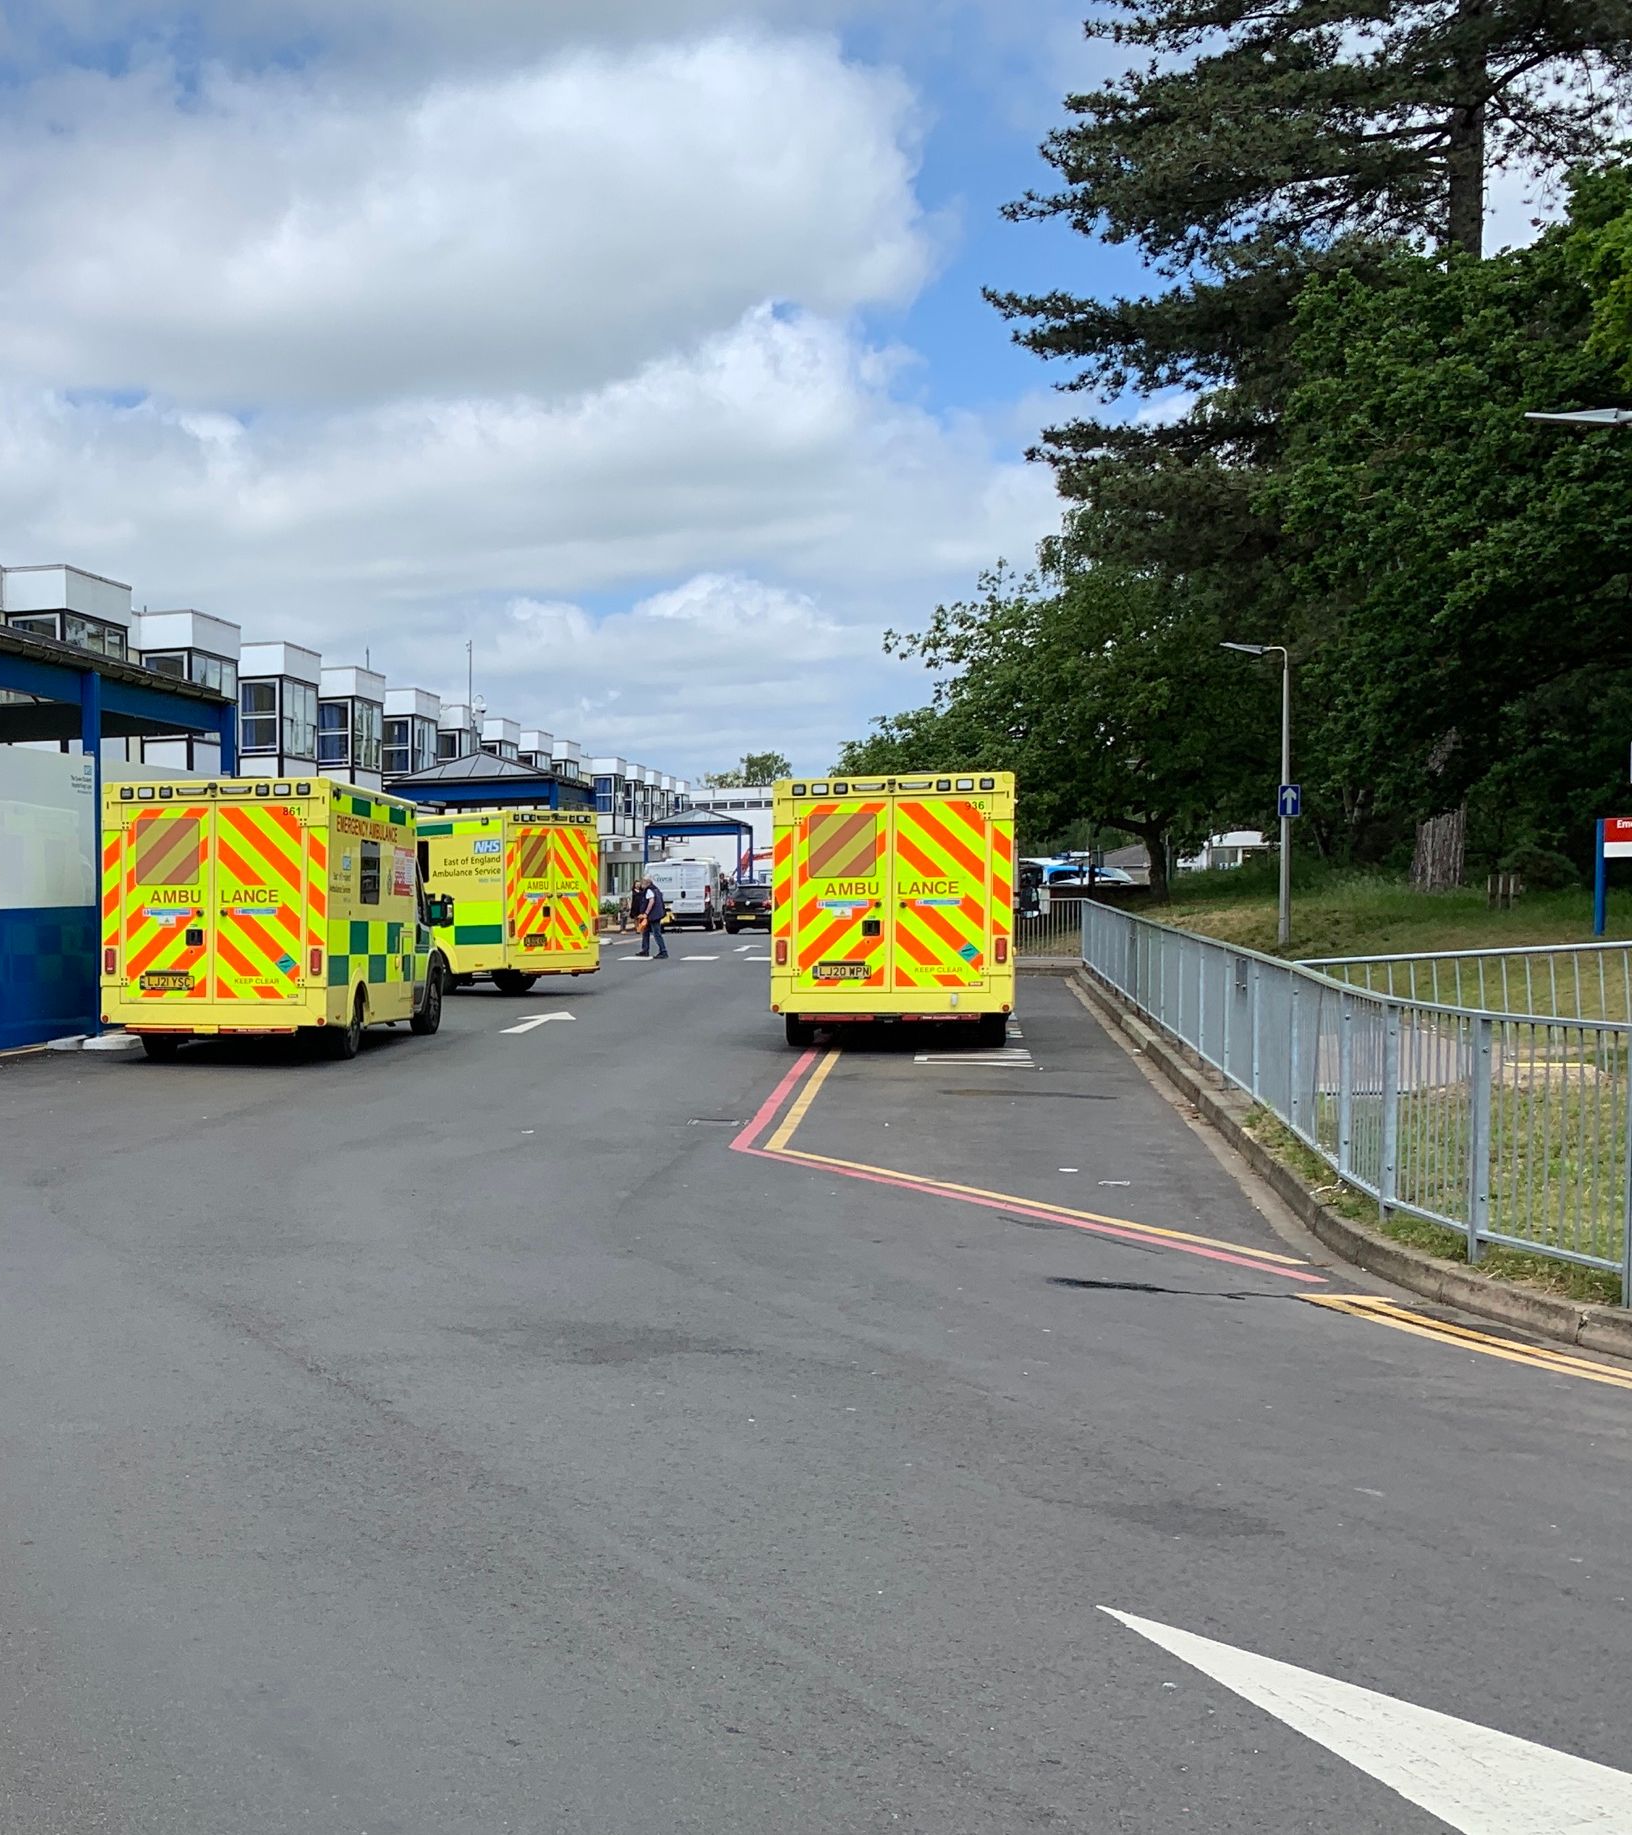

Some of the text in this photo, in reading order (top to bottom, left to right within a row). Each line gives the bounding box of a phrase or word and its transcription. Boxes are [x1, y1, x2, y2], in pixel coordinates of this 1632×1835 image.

[965, 801, 985, 810] 936
[282, 807, 301, 816] 861
[475, 840, 500, 853] NHS
[444, 855, 501, 866] East of England
[432, 867, 501, 878] Ambulance Service
[528, 881, 579, 890] AMBU LANCE
[825, 881, 959, 896] AMBU LANCE
[150, 889, 278, 903] AMBU LANCE
[819, 967, 869, 976] LJ20 WPN
[148, 976, 190, 987] LJ21 YSC
